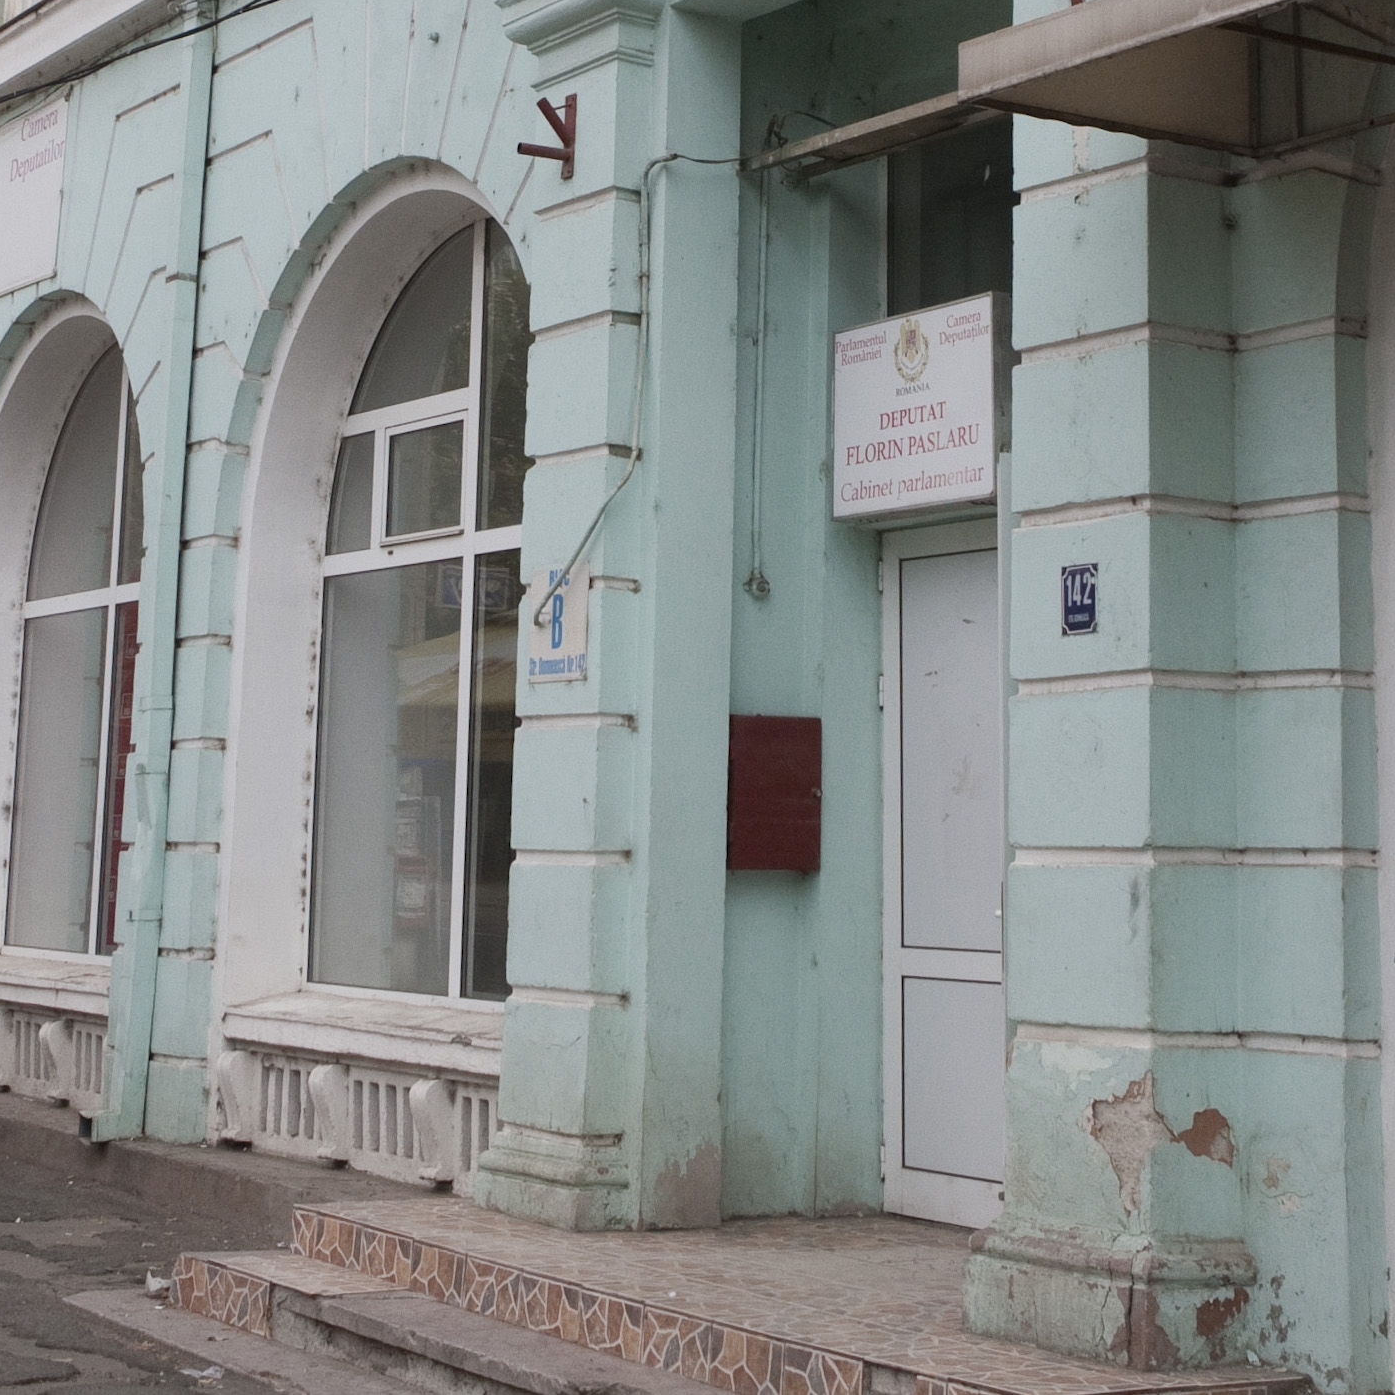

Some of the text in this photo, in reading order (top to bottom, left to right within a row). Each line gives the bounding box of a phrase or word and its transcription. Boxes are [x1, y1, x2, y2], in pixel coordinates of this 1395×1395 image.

[21, 108, 60, 142] Camera
[946, 310, 982, 329] Camera
[835, 330, 888, 355] Parlamentul
[840, 348, 883, 367] României
[879, 401, 947, 431] DEPUTAT
[845, 423, 981, 467] FLORIN PASLARU
[840, 465, 985, 503] Cabinet parlamentar
[1066, 572, 1093, 607] 142
[551, 593, 564, 650] B
